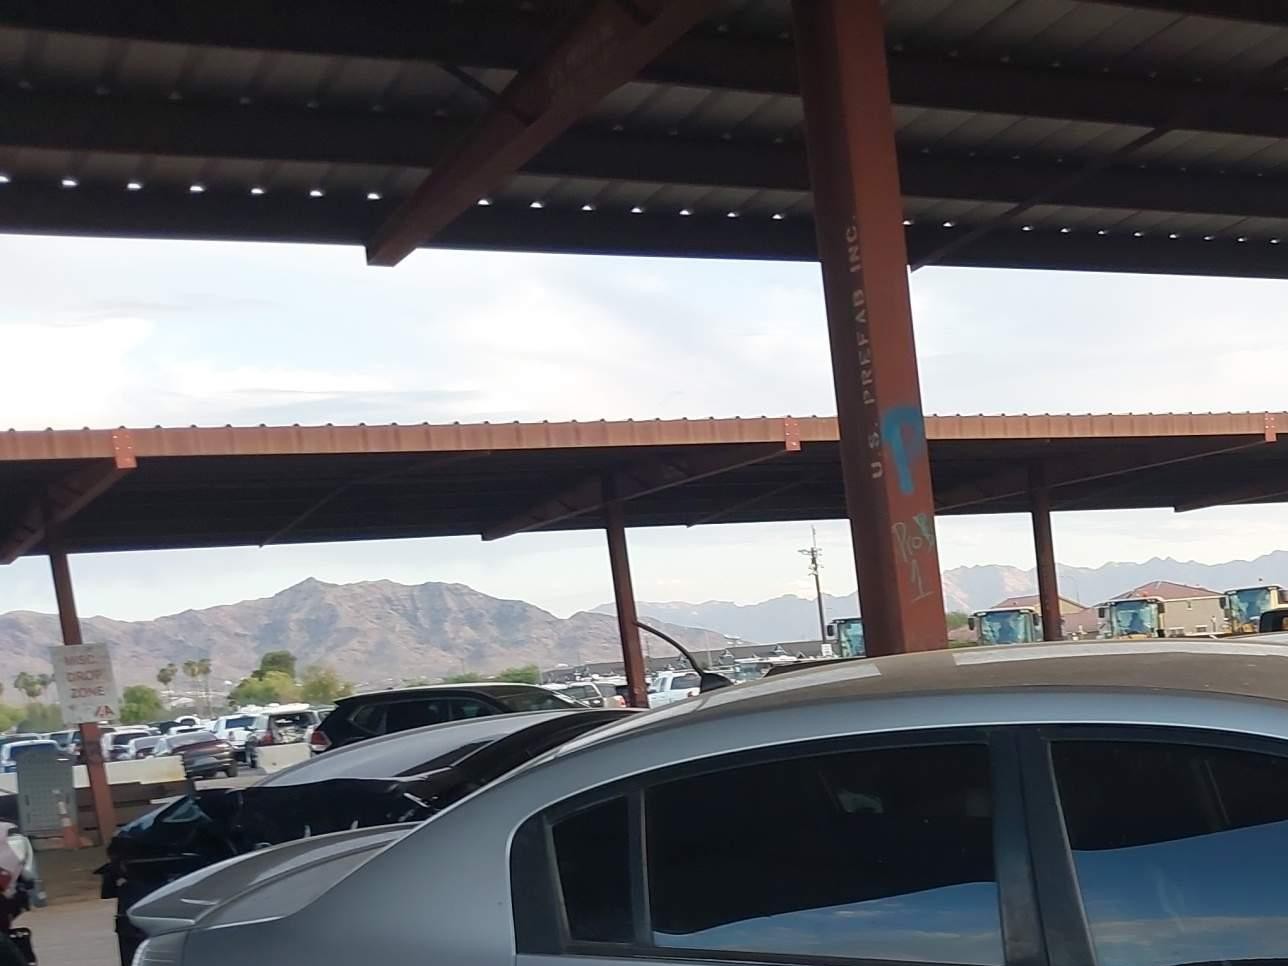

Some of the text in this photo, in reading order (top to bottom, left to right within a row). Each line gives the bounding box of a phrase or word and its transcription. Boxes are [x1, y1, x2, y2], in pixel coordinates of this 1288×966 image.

[846, 215, 883, 479] U.S. PREFAB INC.
[70, 686, 106, 699] ZONE
